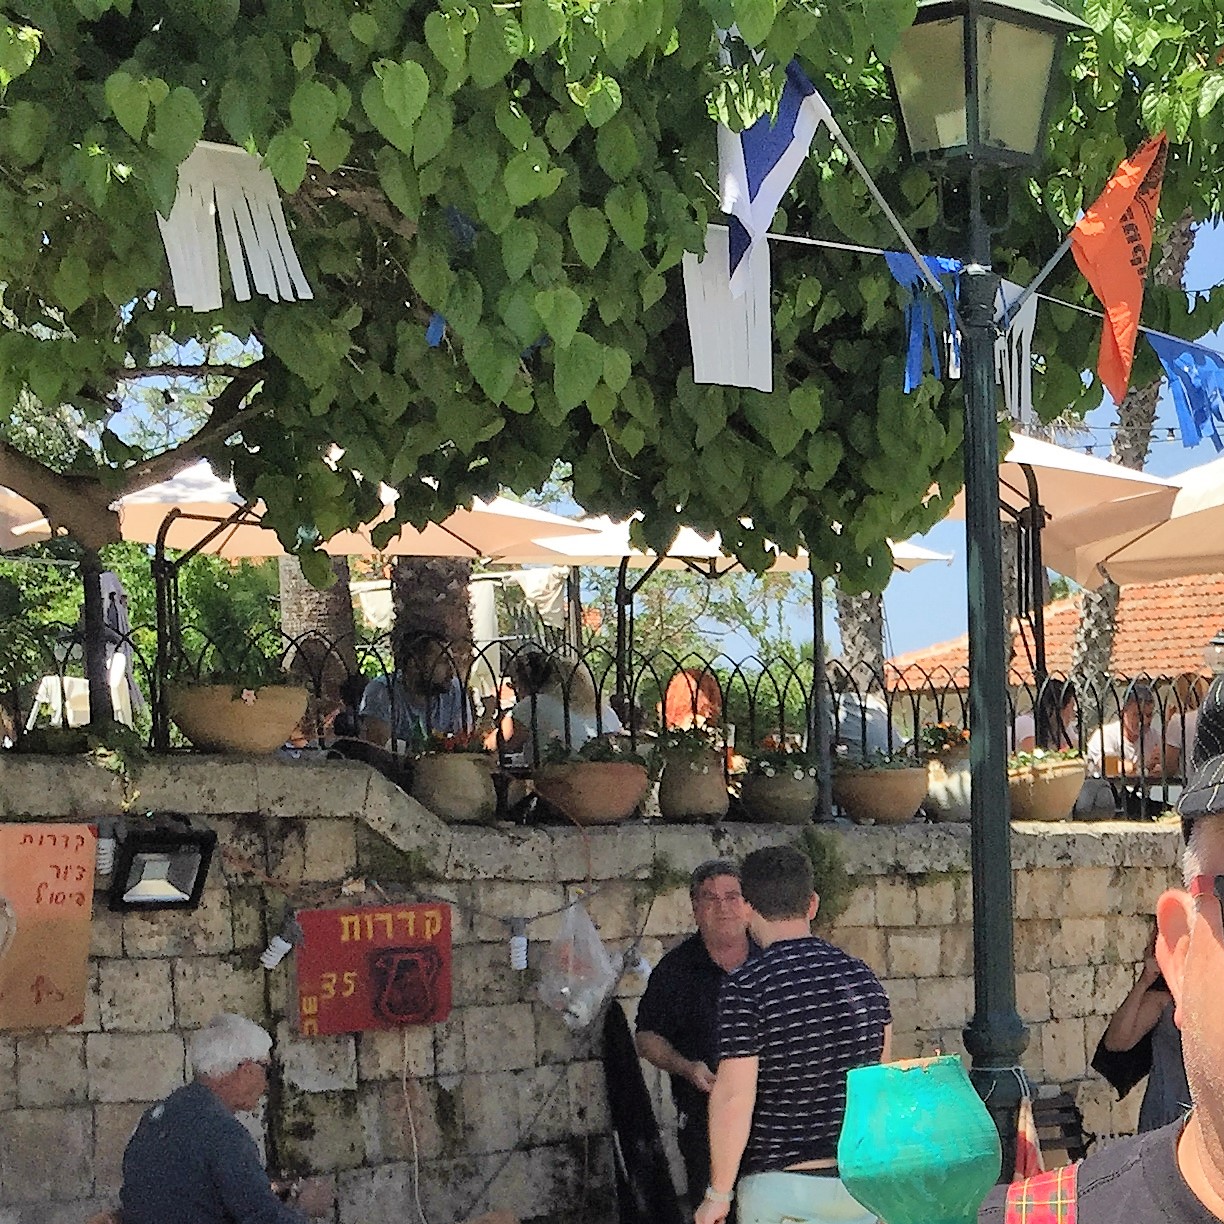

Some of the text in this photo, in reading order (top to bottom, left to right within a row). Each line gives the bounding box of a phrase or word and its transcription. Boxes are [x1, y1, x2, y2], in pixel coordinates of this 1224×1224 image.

[19, 834, 85, 852] קדרות
[340, 909, 442, 944] קדרות
[318, 970, 358, 999] 35
